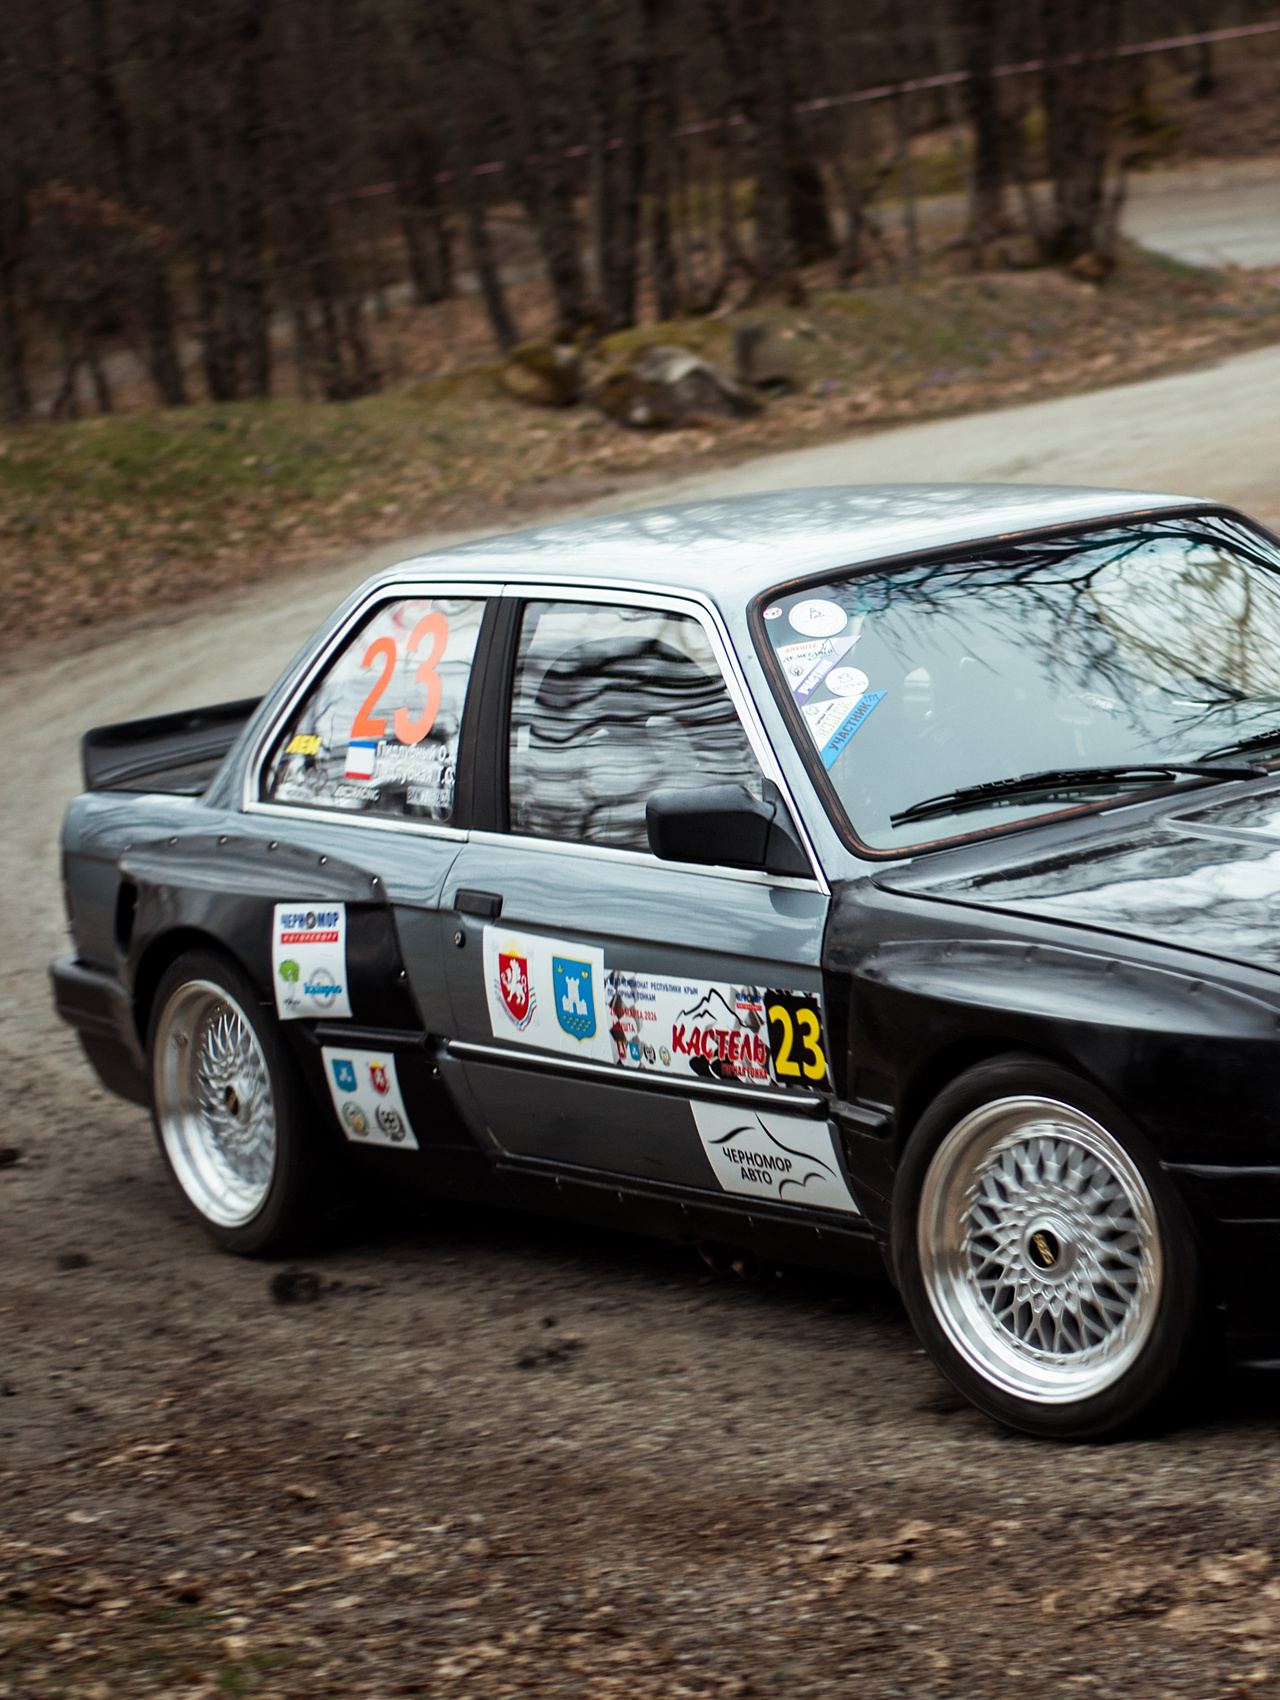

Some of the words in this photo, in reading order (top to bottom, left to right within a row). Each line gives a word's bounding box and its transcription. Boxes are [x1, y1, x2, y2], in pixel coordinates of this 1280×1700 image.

[350, 611, 449, 745] 23
[828, 701, 872, 752] УЧАСТНИК
[651, 981, 682, 994] РЕСПУБЛИКИ
[671, 1023, 766, 1066] КАСТЕЛЬ
[768, 1004, 826, 1081] 23
[722, 1146, 793, 1173] ЧЕРНОМОР
[740, 1167, 773, 1185] АВТО
